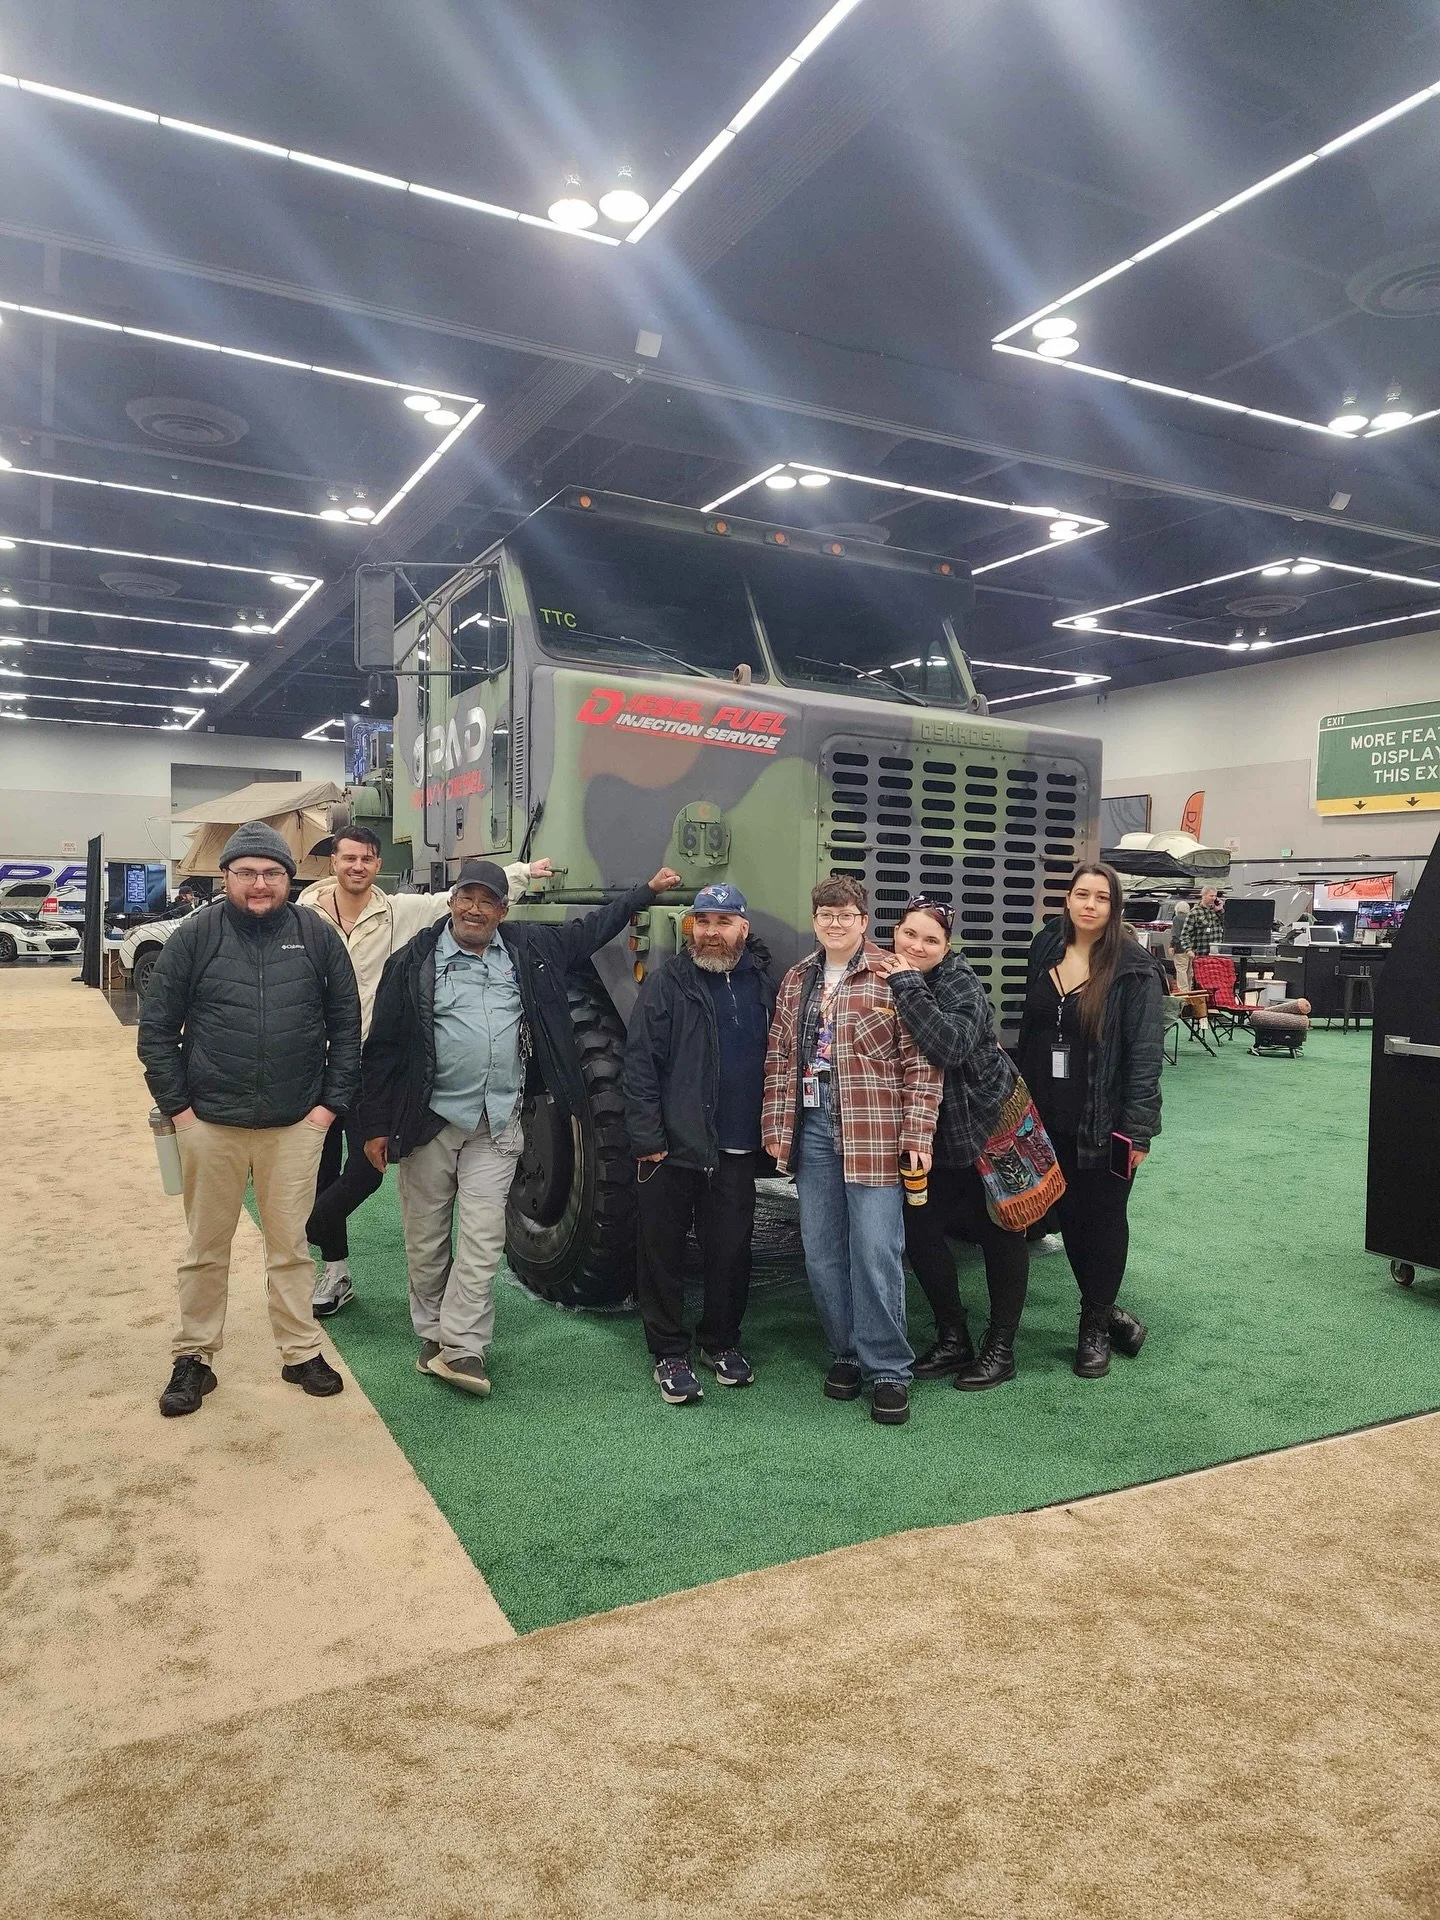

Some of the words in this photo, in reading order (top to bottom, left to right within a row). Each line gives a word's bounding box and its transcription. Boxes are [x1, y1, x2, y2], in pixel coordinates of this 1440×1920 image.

[539, 608, 577, 628] TTC
[576, 687, 704, 725] DIESEL
[711, 706, 787, 736] FUEL
[1327, 716, 1346, 727] EXIT
[616, 713, 701, 737] INJECTION
[703, 727, 781, 750] SERVICE
[921, 722, 1003, 749] OSHKOSH
[1350, 732, 1397, 750] MORE
[1401, 727, 1440, 745] FEA
[1373, 768, 1410, 784] THIS
